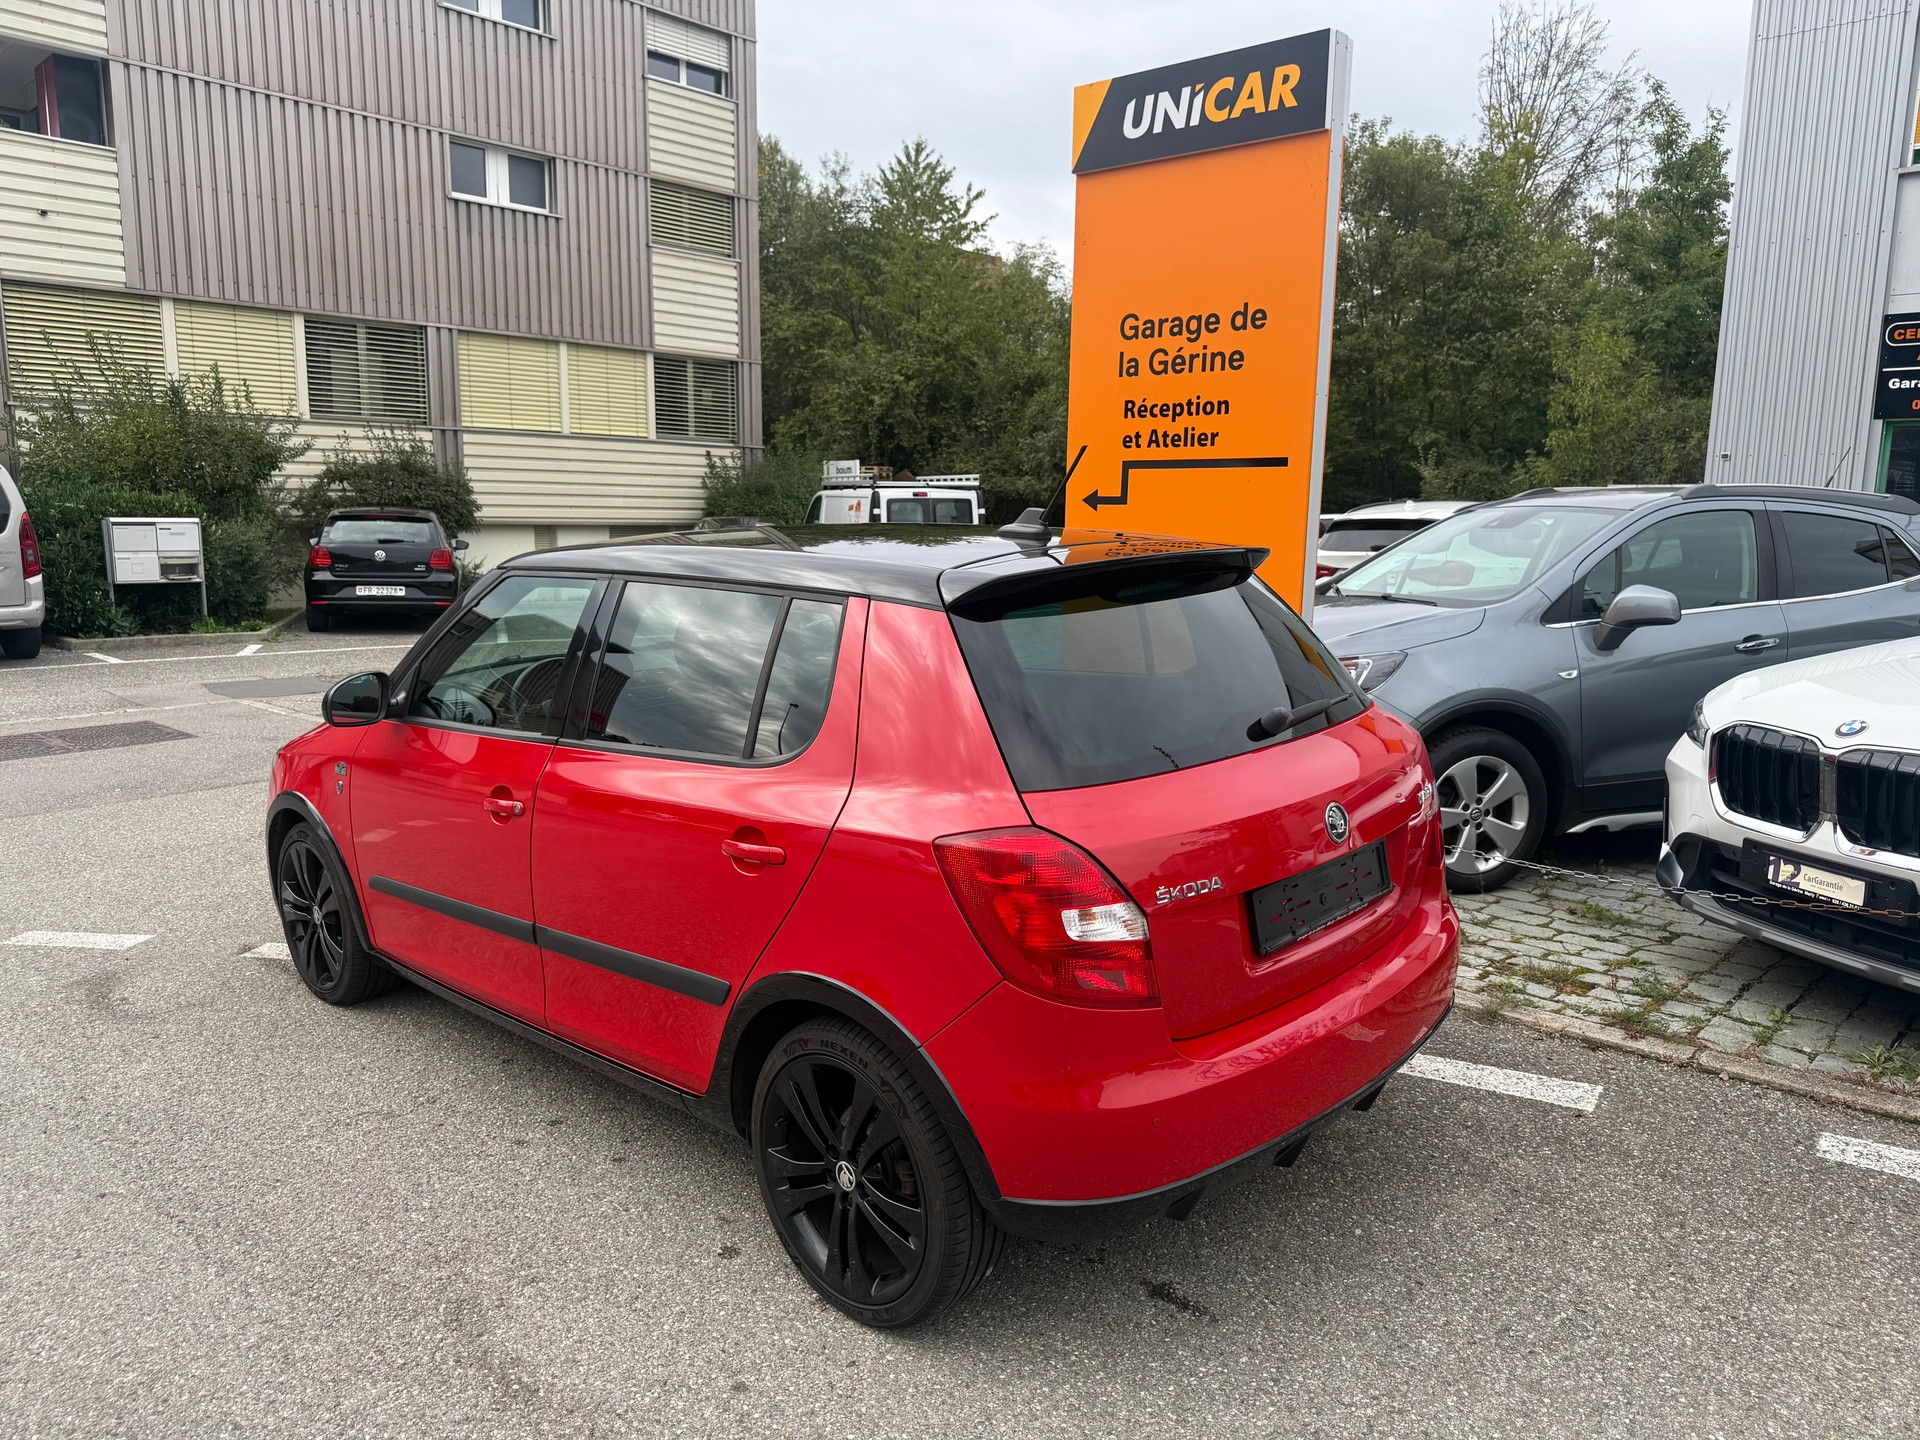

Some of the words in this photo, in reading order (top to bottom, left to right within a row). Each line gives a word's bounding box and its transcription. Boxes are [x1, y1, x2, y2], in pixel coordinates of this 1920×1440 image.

[1120, 312, 1220, 343] Garage
[1230, 302, 1268, 331] de
[1894, 328, 1920, 340] CE
[1118, 351, 1139, 377] la
[1149, 345, 1245, 376] Gérine
[1123, 395, 1230, 422] Réception
[1122, 431, 1142, 449] et
[1146, 427, 1219, 448] Atelier
[1769, 857, 1801, 888] 12
[1803, 873, 1844, 892] CarGarantie
[1156, 876, 1224, 904] ŠKODA
[820, 1039, 869, 1070] NEXEN
